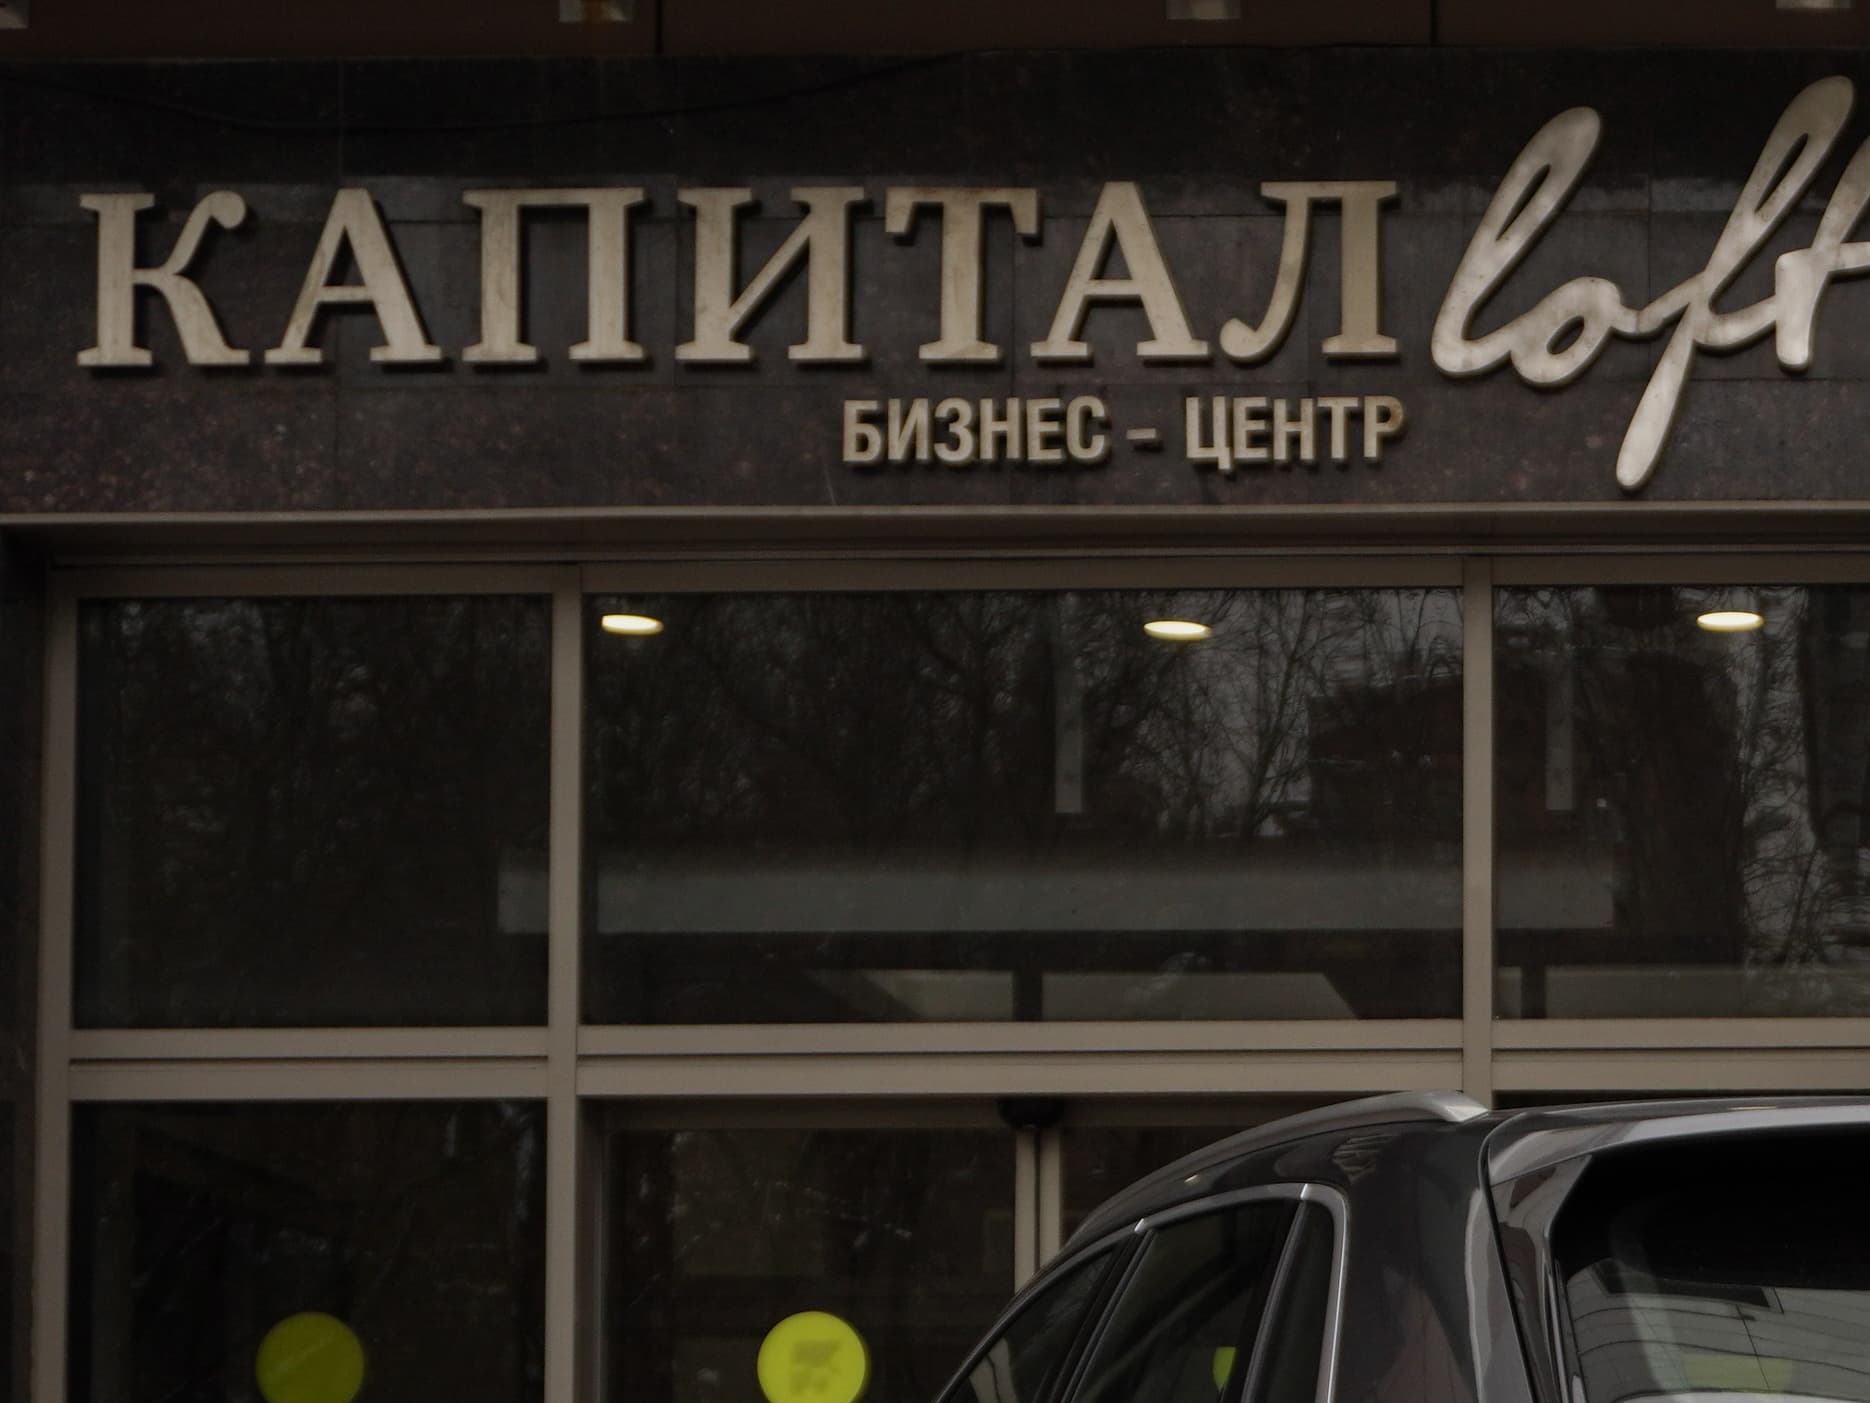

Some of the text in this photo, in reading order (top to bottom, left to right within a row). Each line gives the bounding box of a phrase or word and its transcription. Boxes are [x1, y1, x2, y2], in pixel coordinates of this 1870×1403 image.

[77, 181, 1399, 368] КАПИТАЛ
[842, 395, 1108, 465] БИЗНЕС
[1185, 396, 1405, 473] ЦЕНТР
